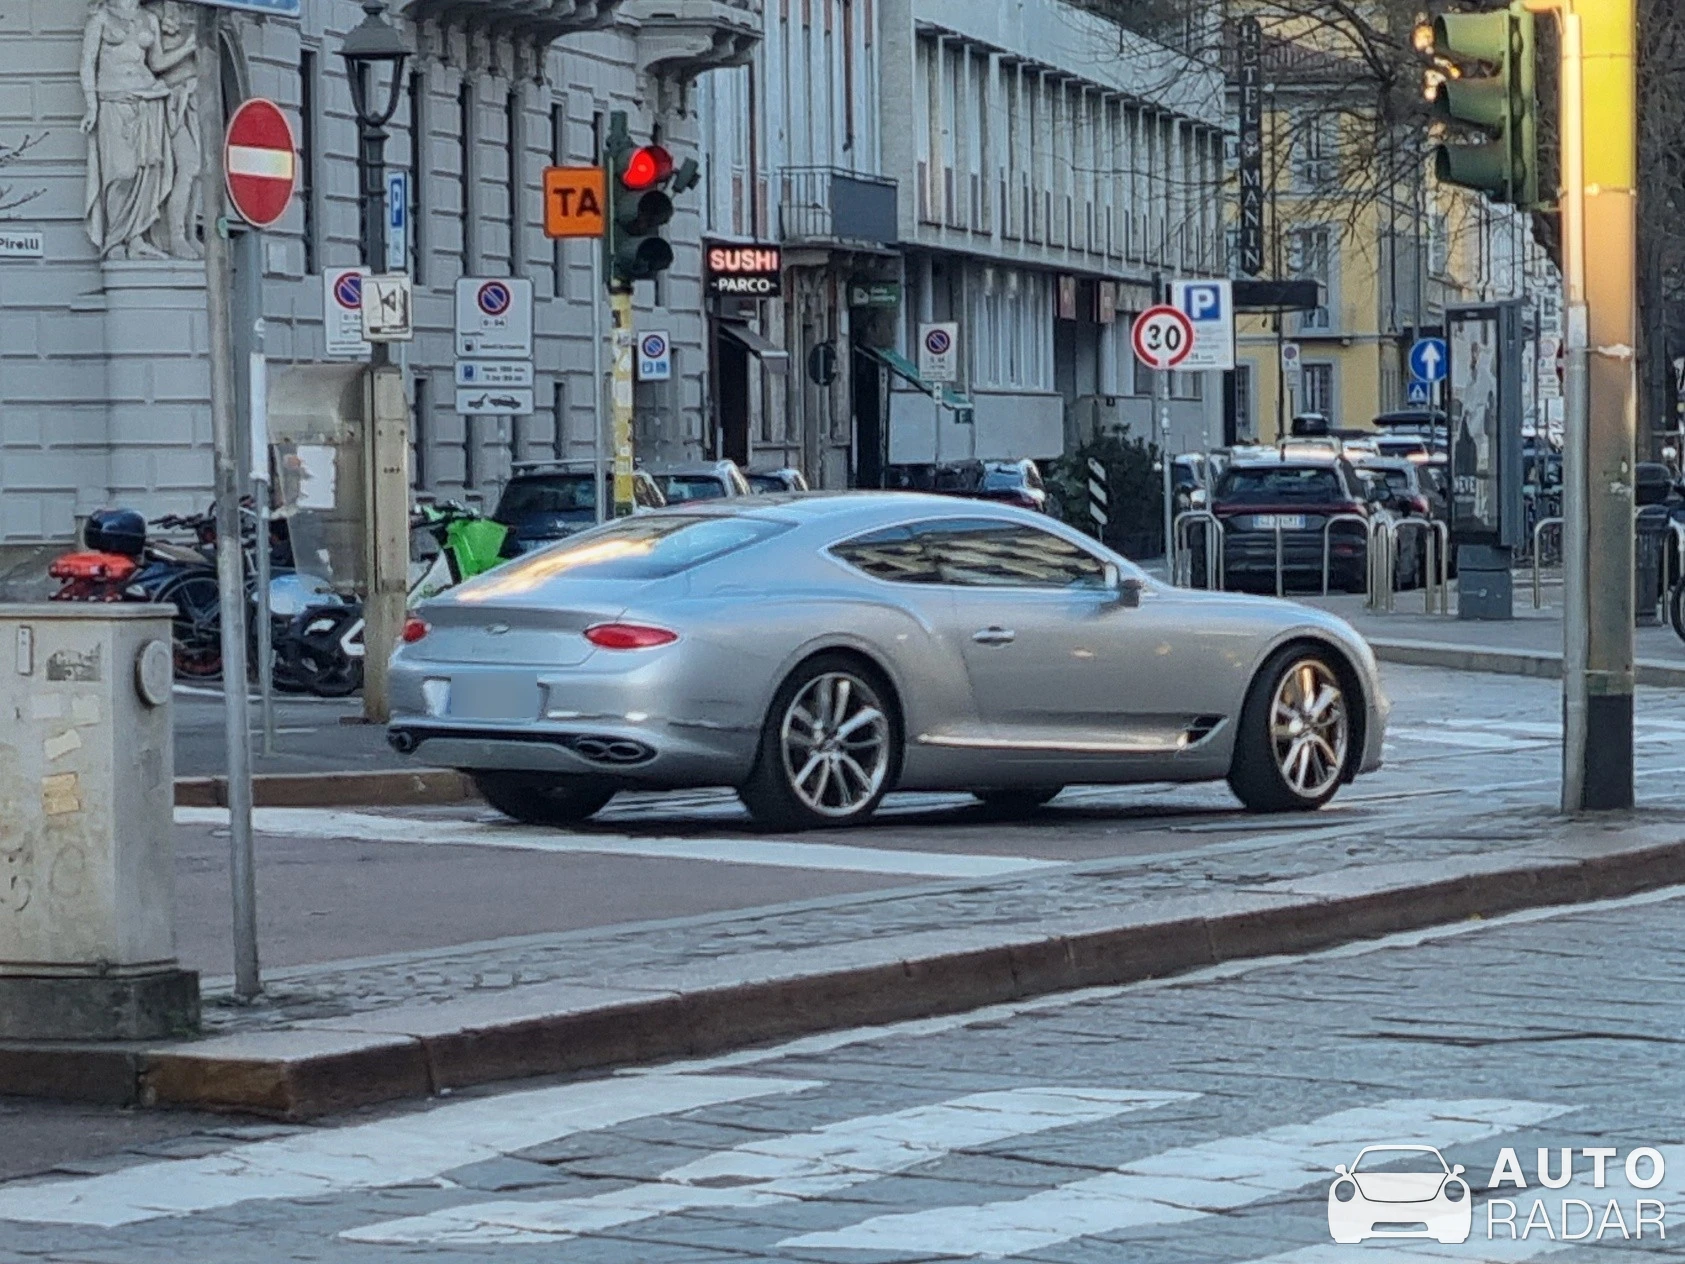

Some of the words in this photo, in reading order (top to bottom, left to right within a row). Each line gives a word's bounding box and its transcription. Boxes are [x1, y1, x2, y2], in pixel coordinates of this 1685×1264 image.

[1242, 24, 1258, 124] HOTEL
[552, 187, 601, 217] TA
[1242, 168, 1260, 268] MANIN
[710, 248, 778, 272] SUSHI
[1191, 288, 1215, 319] P
[1147, 324, 1181, 351] 30
